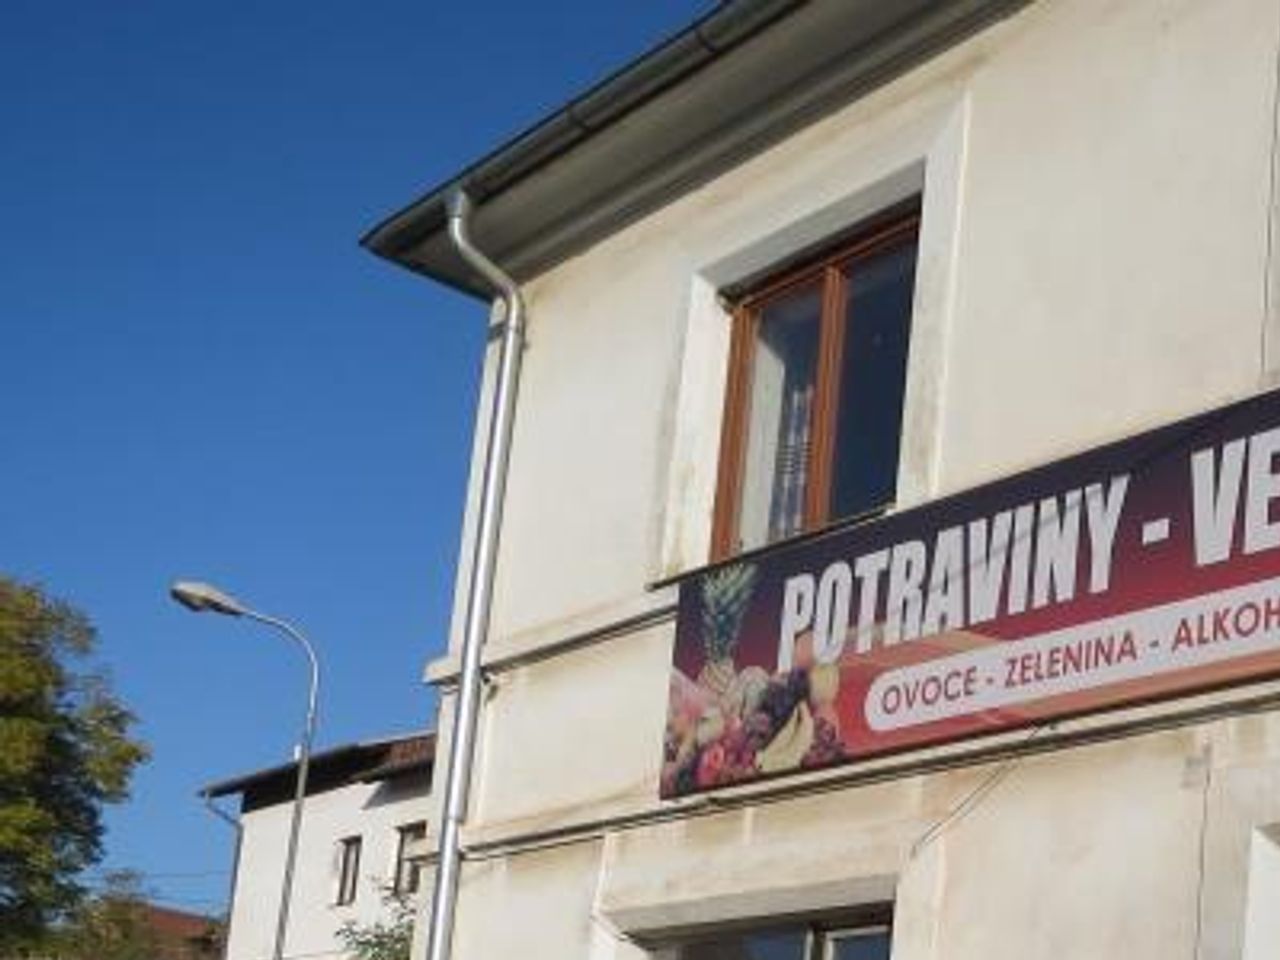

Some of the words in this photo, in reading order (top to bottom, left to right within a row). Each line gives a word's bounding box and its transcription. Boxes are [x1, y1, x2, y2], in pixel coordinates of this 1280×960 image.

[777, 472, 1131, 674] POTRAVINY
[882, 665, 978, 716] OVOCE
[1005, 631, 1138, 690] ZELENINA
